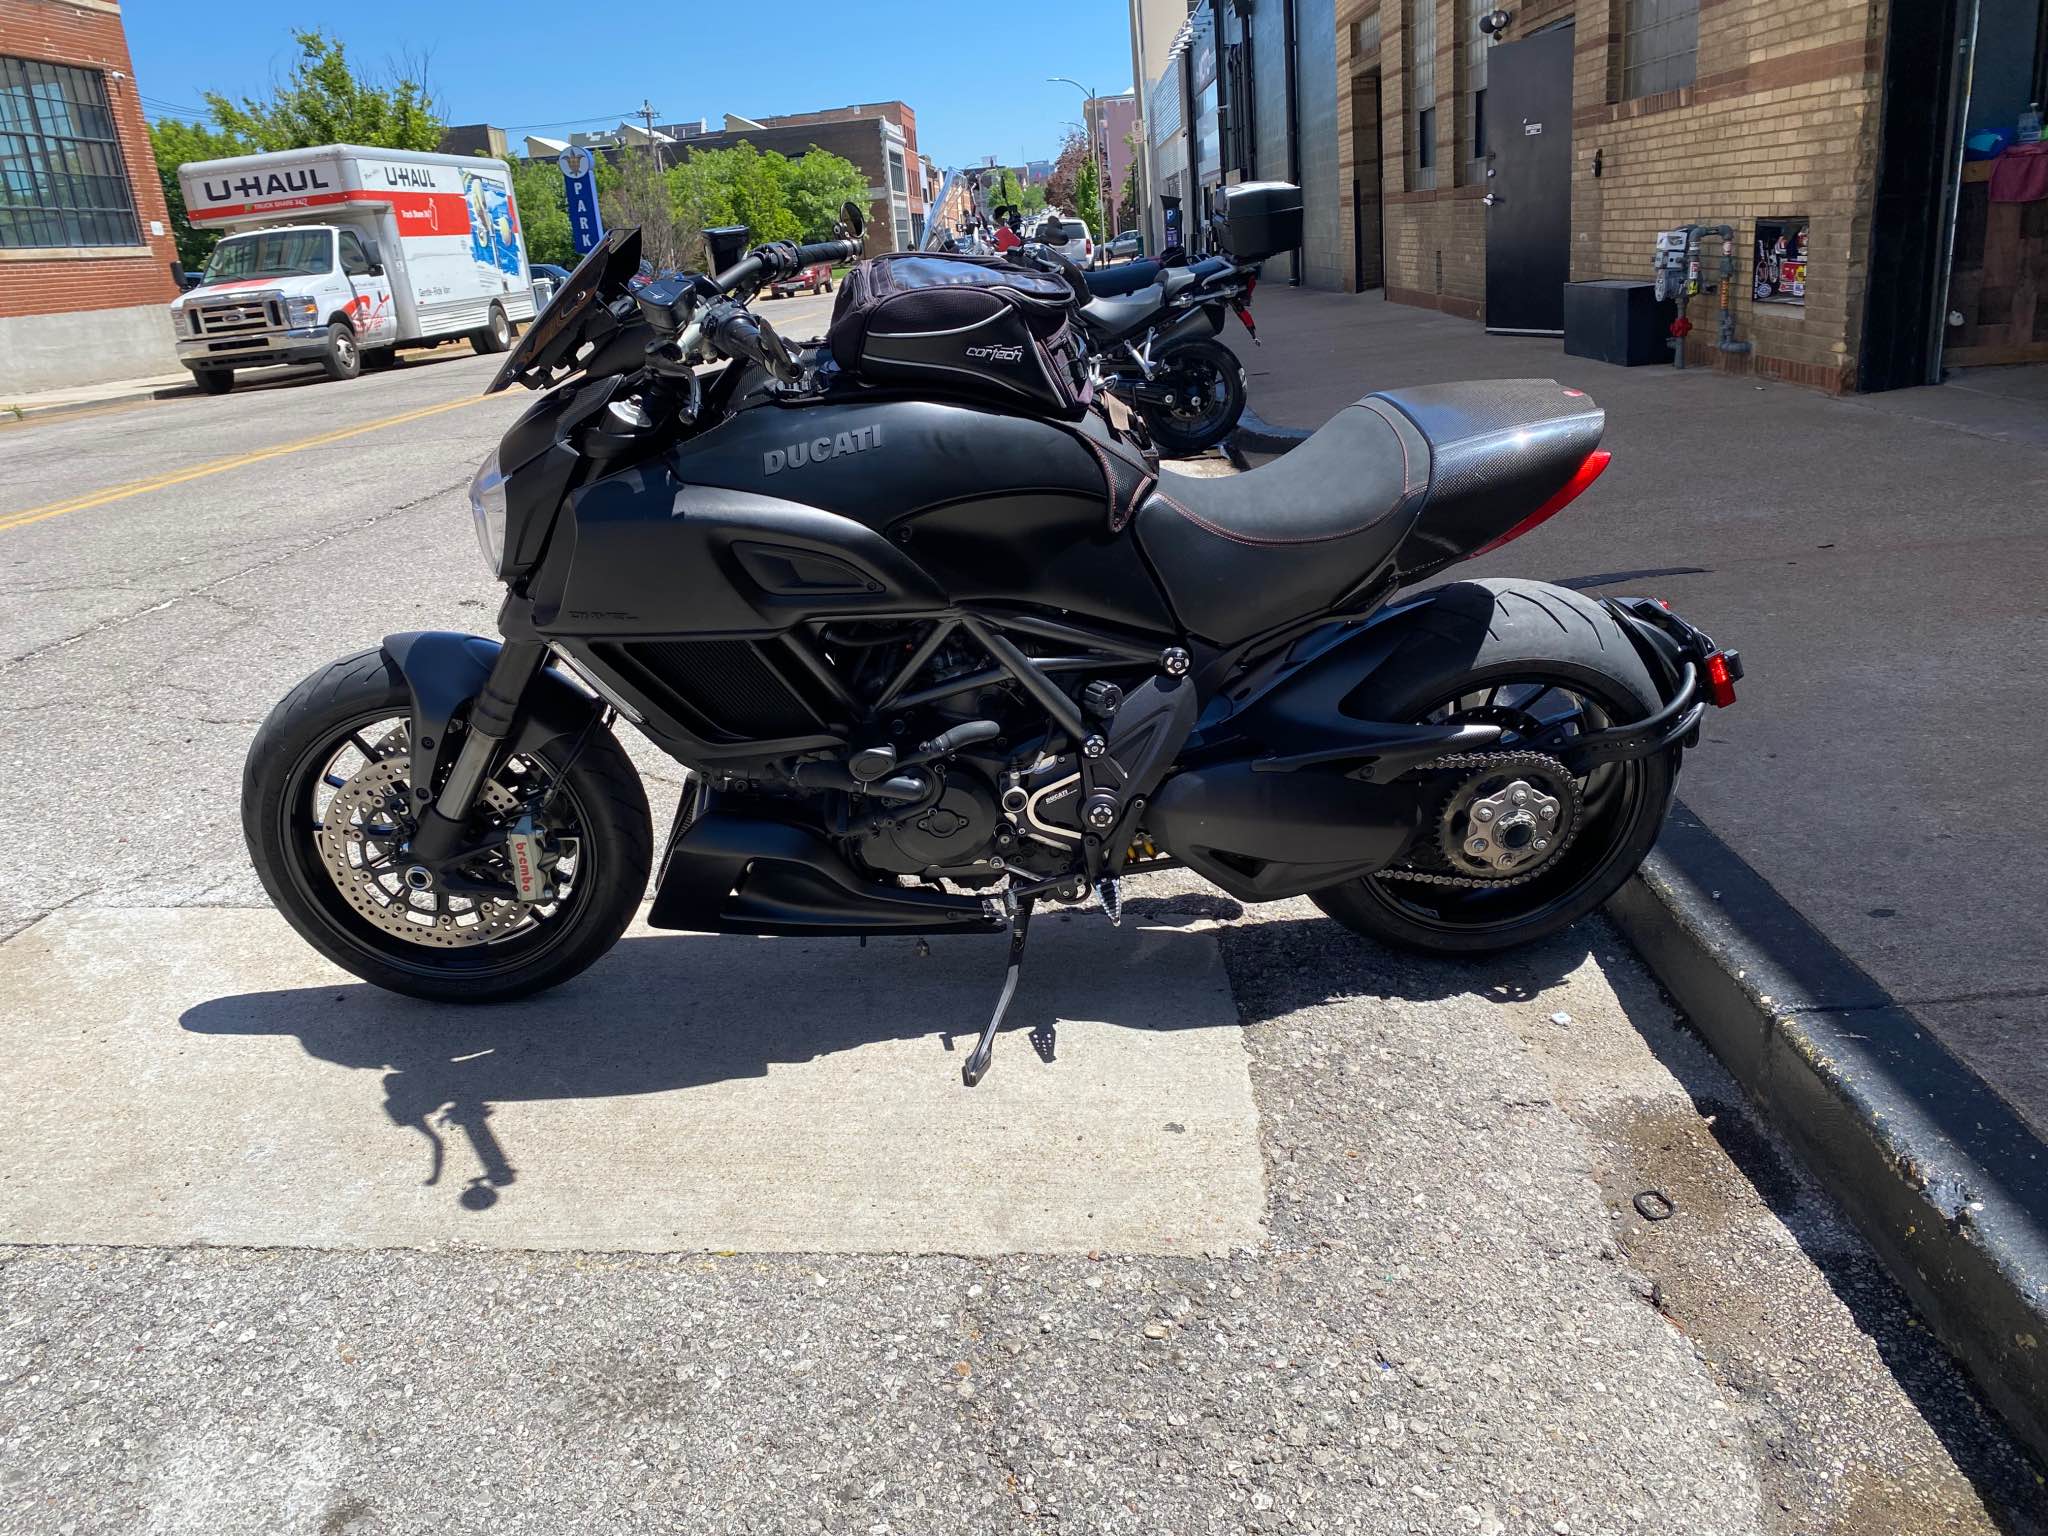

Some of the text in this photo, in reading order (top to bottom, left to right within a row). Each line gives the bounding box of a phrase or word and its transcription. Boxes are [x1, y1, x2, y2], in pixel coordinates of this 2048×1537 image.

[204, 169, 329, 201] U-HAUL
[384, 167, 436, 187] U-HAUL
[574, 182, 592, 246] PARK
[1166, 209, 1173, 220] P
[966, 344, 1024, 362] cortech
[763, 424, 882, 476] DUCATI
[1045, 789, 1068, 804] DUCATI
[515, 841, 535, 892] brembo
